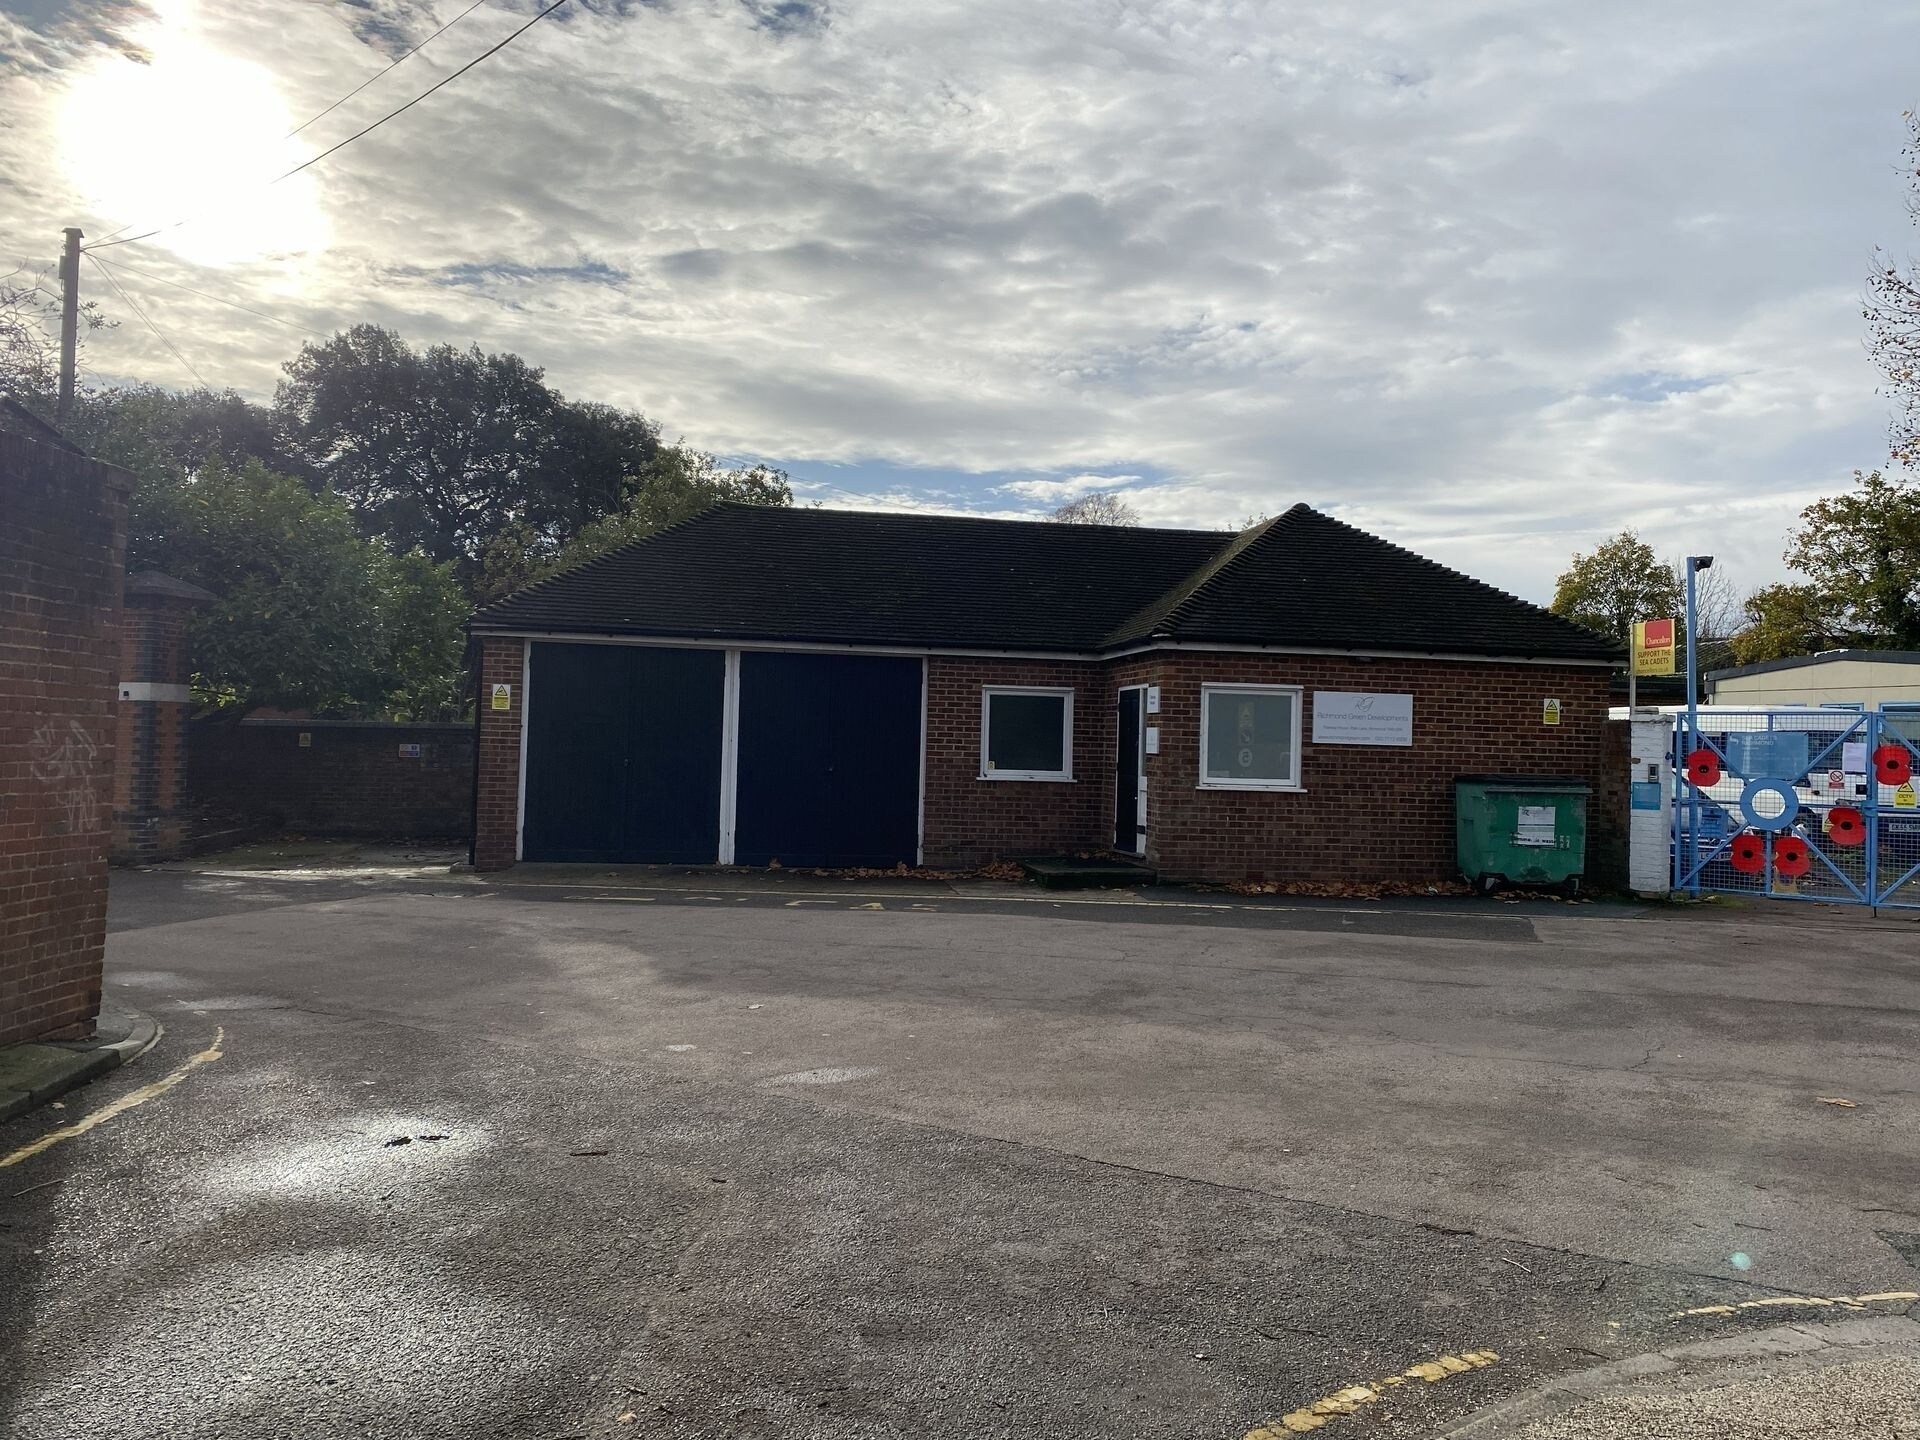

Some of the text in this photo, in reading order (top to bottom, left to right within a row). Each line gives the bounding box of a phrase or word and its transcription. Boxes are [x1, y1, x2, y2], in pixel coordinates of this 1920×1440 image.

[1637, 650, 1660, 658] SUPPORT
[1650, 657, 1669, 665] CADETS
[1317, 711, 1409, 721] Richmond Green Developments
